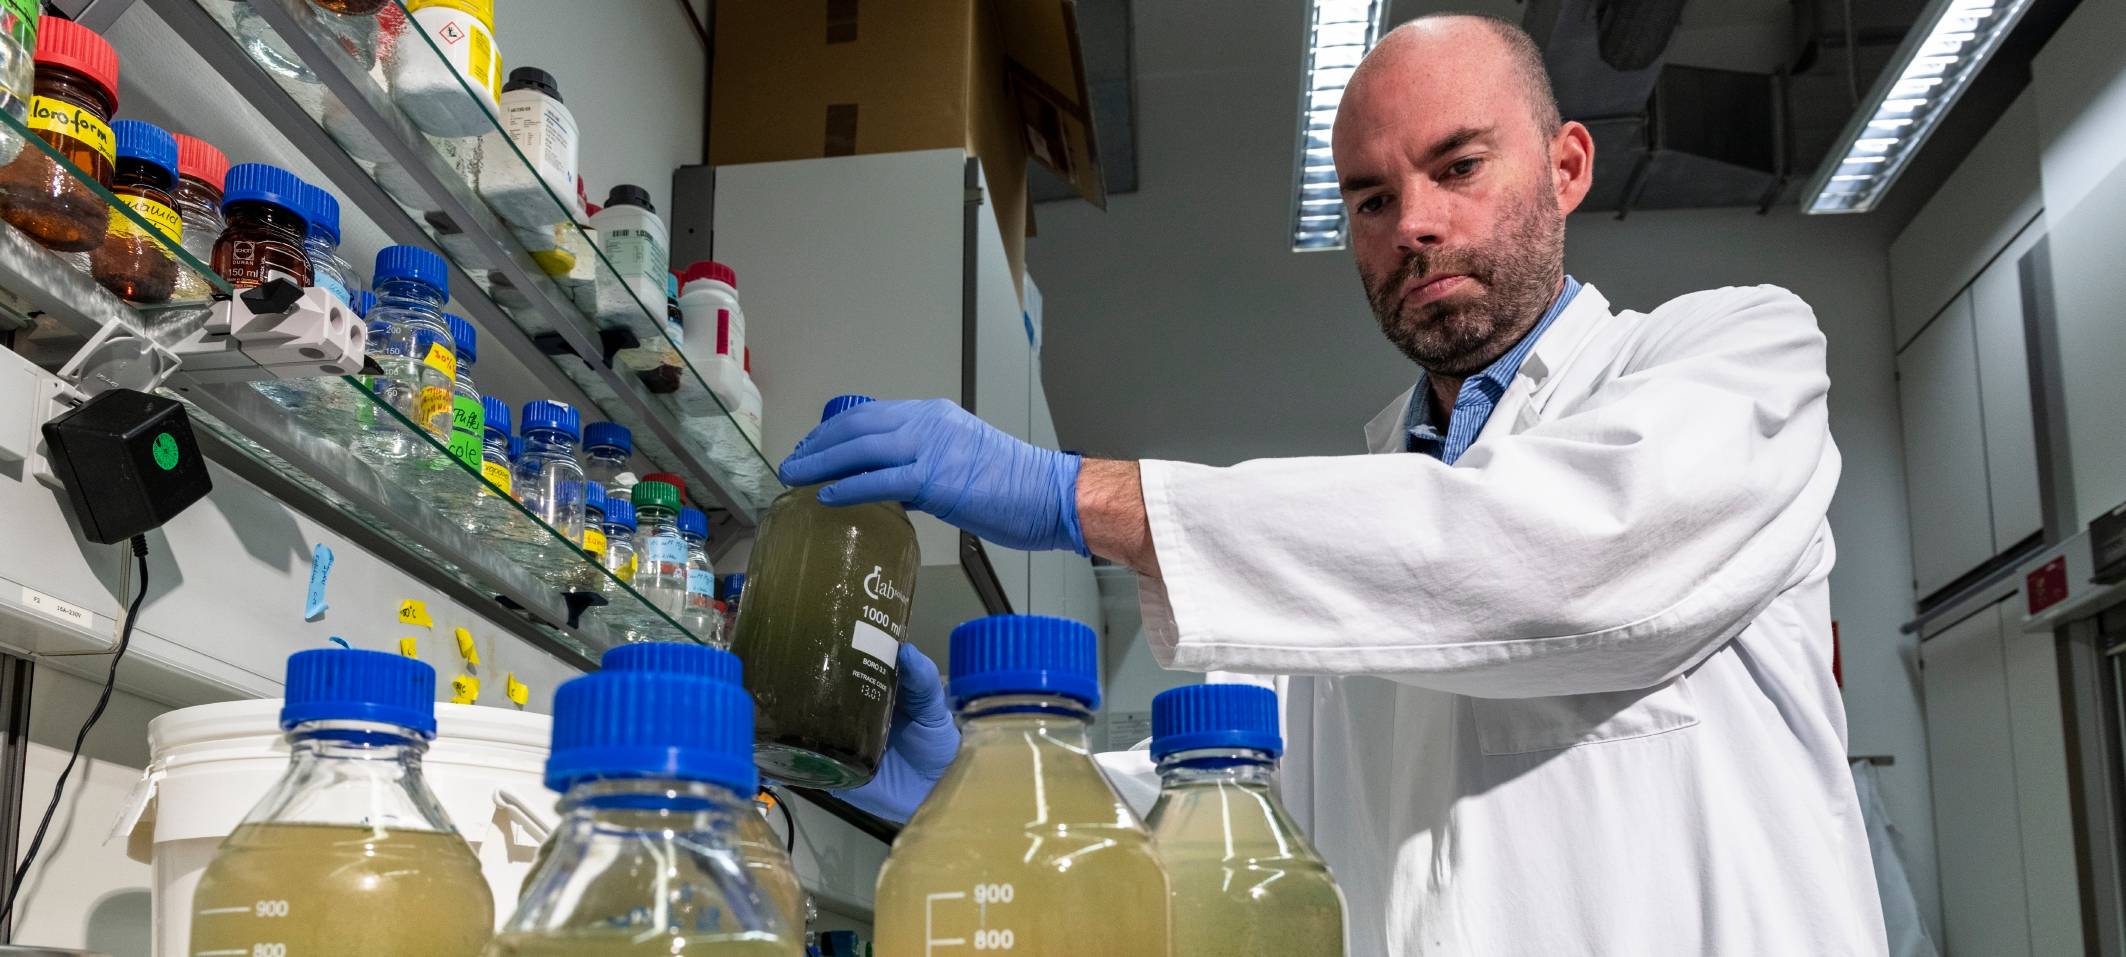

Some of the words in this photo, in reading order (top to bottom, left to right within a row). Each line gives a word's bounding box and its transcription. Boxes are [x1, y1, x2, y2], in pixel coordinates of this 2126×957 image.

[30, 100, 108, 144] loroform
[228, 268, 244, 277] 150
[246, 269, 259, 278] ml
[386, 325, 401, 334] 200
[385, 347, 400, 355] 150
[862, 605, 890, 627] 1000
[890, 622, 901, 637] ml
[852, 670, 877, 685] RETRACE
[973, 882, 1014, 904] 900
[255, 900, 289, 918] 900
[973, 929, 1014, 951] 800
[252, 943, 287, 957] 800
